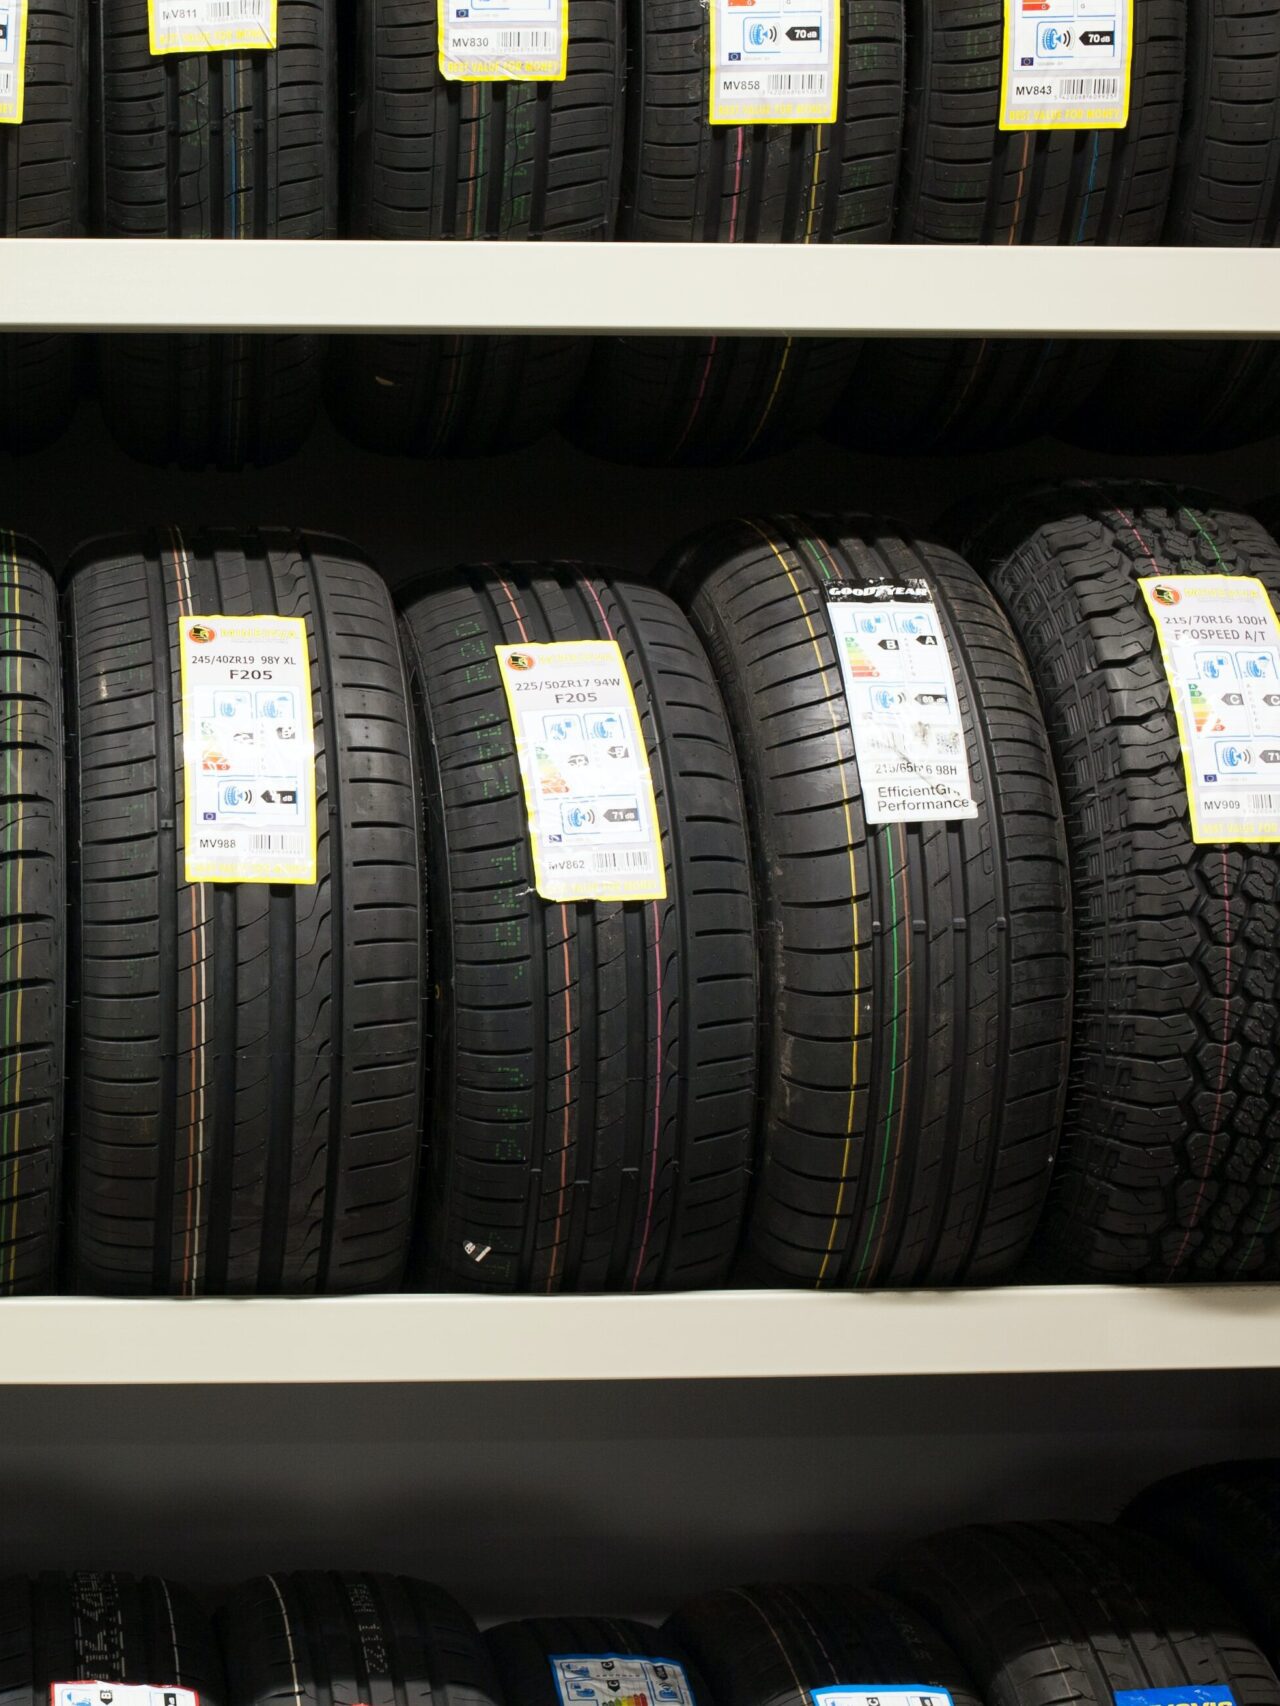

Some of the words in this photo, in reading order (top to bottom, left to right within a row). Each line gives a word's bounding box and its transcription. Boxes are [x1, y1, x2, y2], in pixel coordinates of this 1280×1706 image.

[794, 29, 806, 38] 70
[807, 30, 817, 38] dB
[1088, 34, 1100, 43] 70
[1100, 35, 1110, 43] dB
[452, 37, 489, 47] MV830
[723, 80, 761, 90] MV858
[1016, 86, 1052, 96] MV843
[1163, 615, 1233, 626] 215/70R16
[1237, 615, 1268, 625] 100H
[925, 637, 935, 645] A
[1244, 631, 1266, 642] A/T
[886, 641, 896, 650] B
[192, 655, 255, 665] 245/40ZR19
[261, 656, 280, 665] 98Y
[284, 656, 297, 665] XL
[230, 670, 273, 680] F205
[516, 678, 590, 692] 225/50ZR17
[593, 677, 621, 687] 94W
[555, 692, 598, 704] F205
[1230, 695, 1240, 705] C
[935, 765, 957, 775] 98H
[877, 798, 969, 811] Performance
[1204, 801, 1241, 810] MV909
[612, 811, 623, 820] 71
[200, 839, 236, 849] MV988
